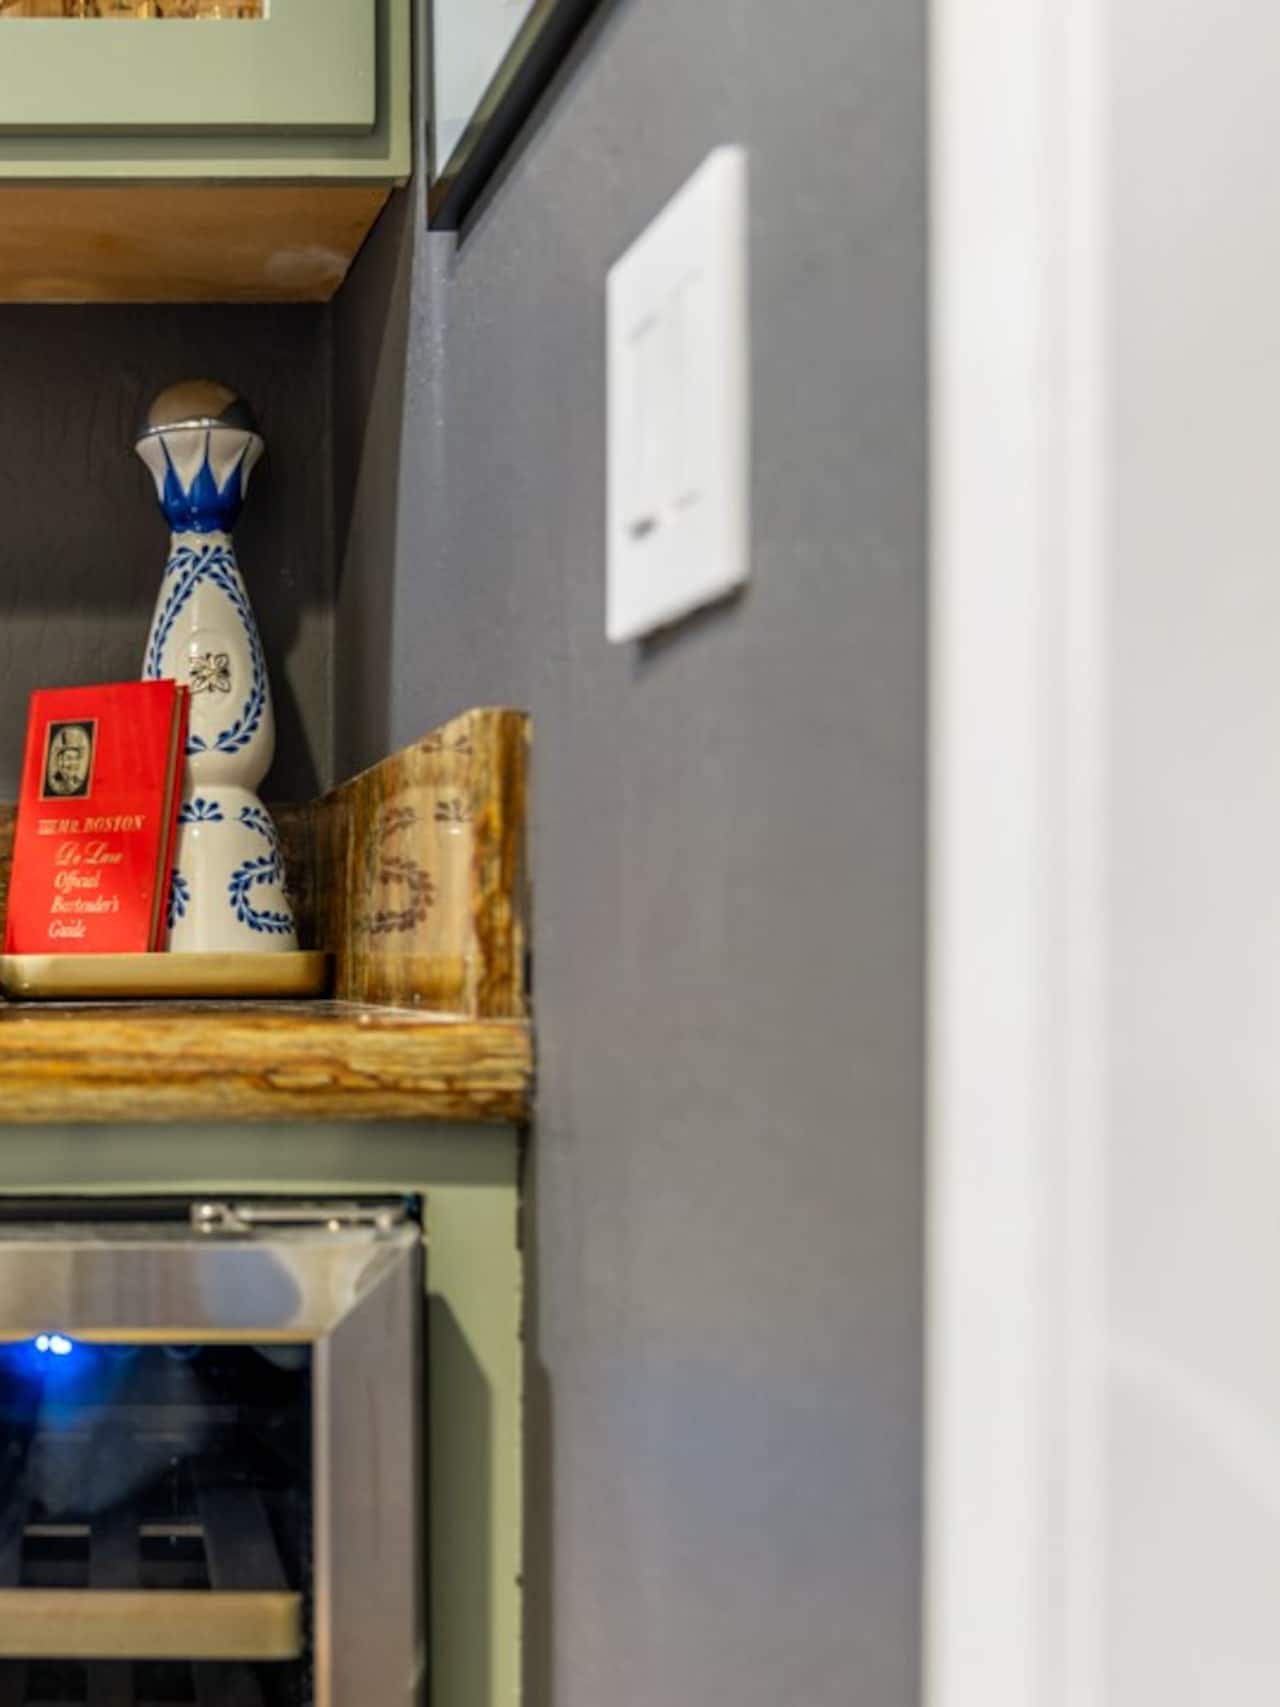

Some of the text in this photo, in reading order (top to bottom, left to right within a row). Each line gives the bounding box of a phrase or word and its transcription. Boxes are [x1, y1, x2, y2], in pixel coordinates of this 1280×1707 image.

[83, 815, 146, 832] BOSTON
[53, 869, 102, 894] Official
[48, 919, 87, 939] Guide
